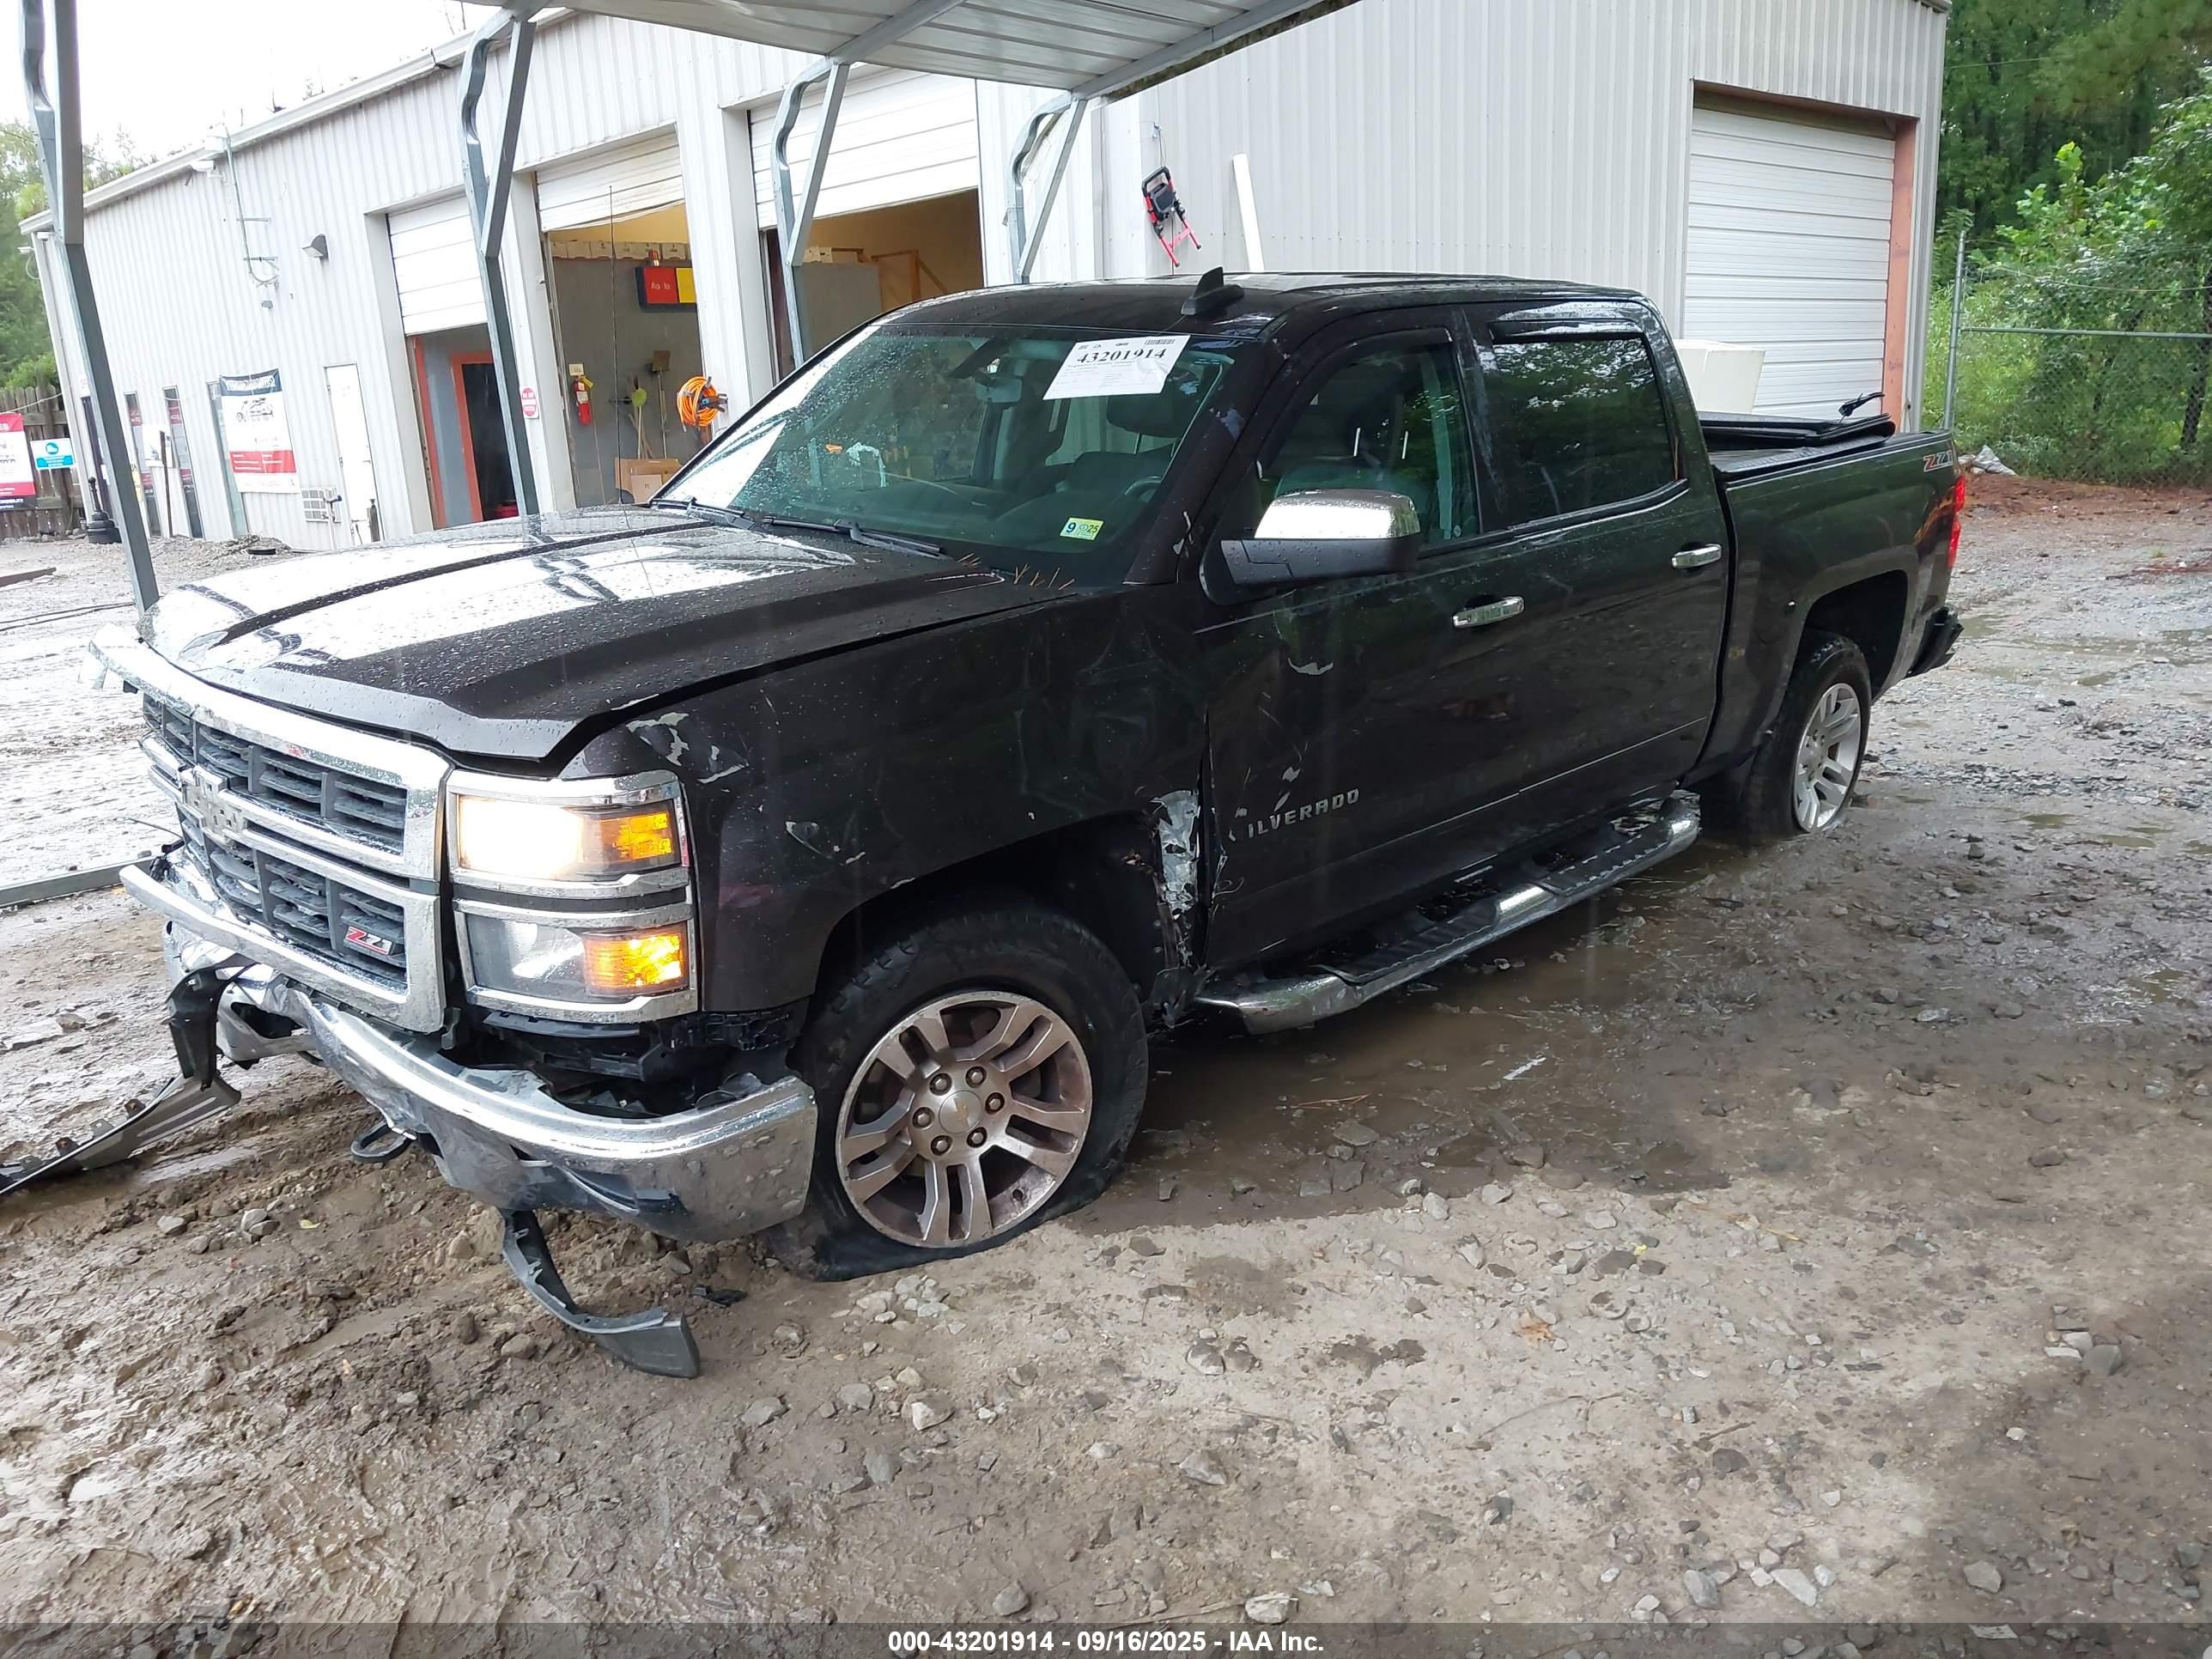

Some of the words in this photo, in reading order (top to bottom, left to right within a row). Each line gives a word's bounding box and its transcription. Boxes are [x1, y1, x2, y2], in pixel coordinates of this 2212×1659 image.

[1077, 348, 1168, 364] 43201914
[1923, 449, 1954, 473] Z71
[1066, 521, 1077, 533] 9
[1086, 524, 1100, 533] 25
[345, 926, 393, 956] Z71
